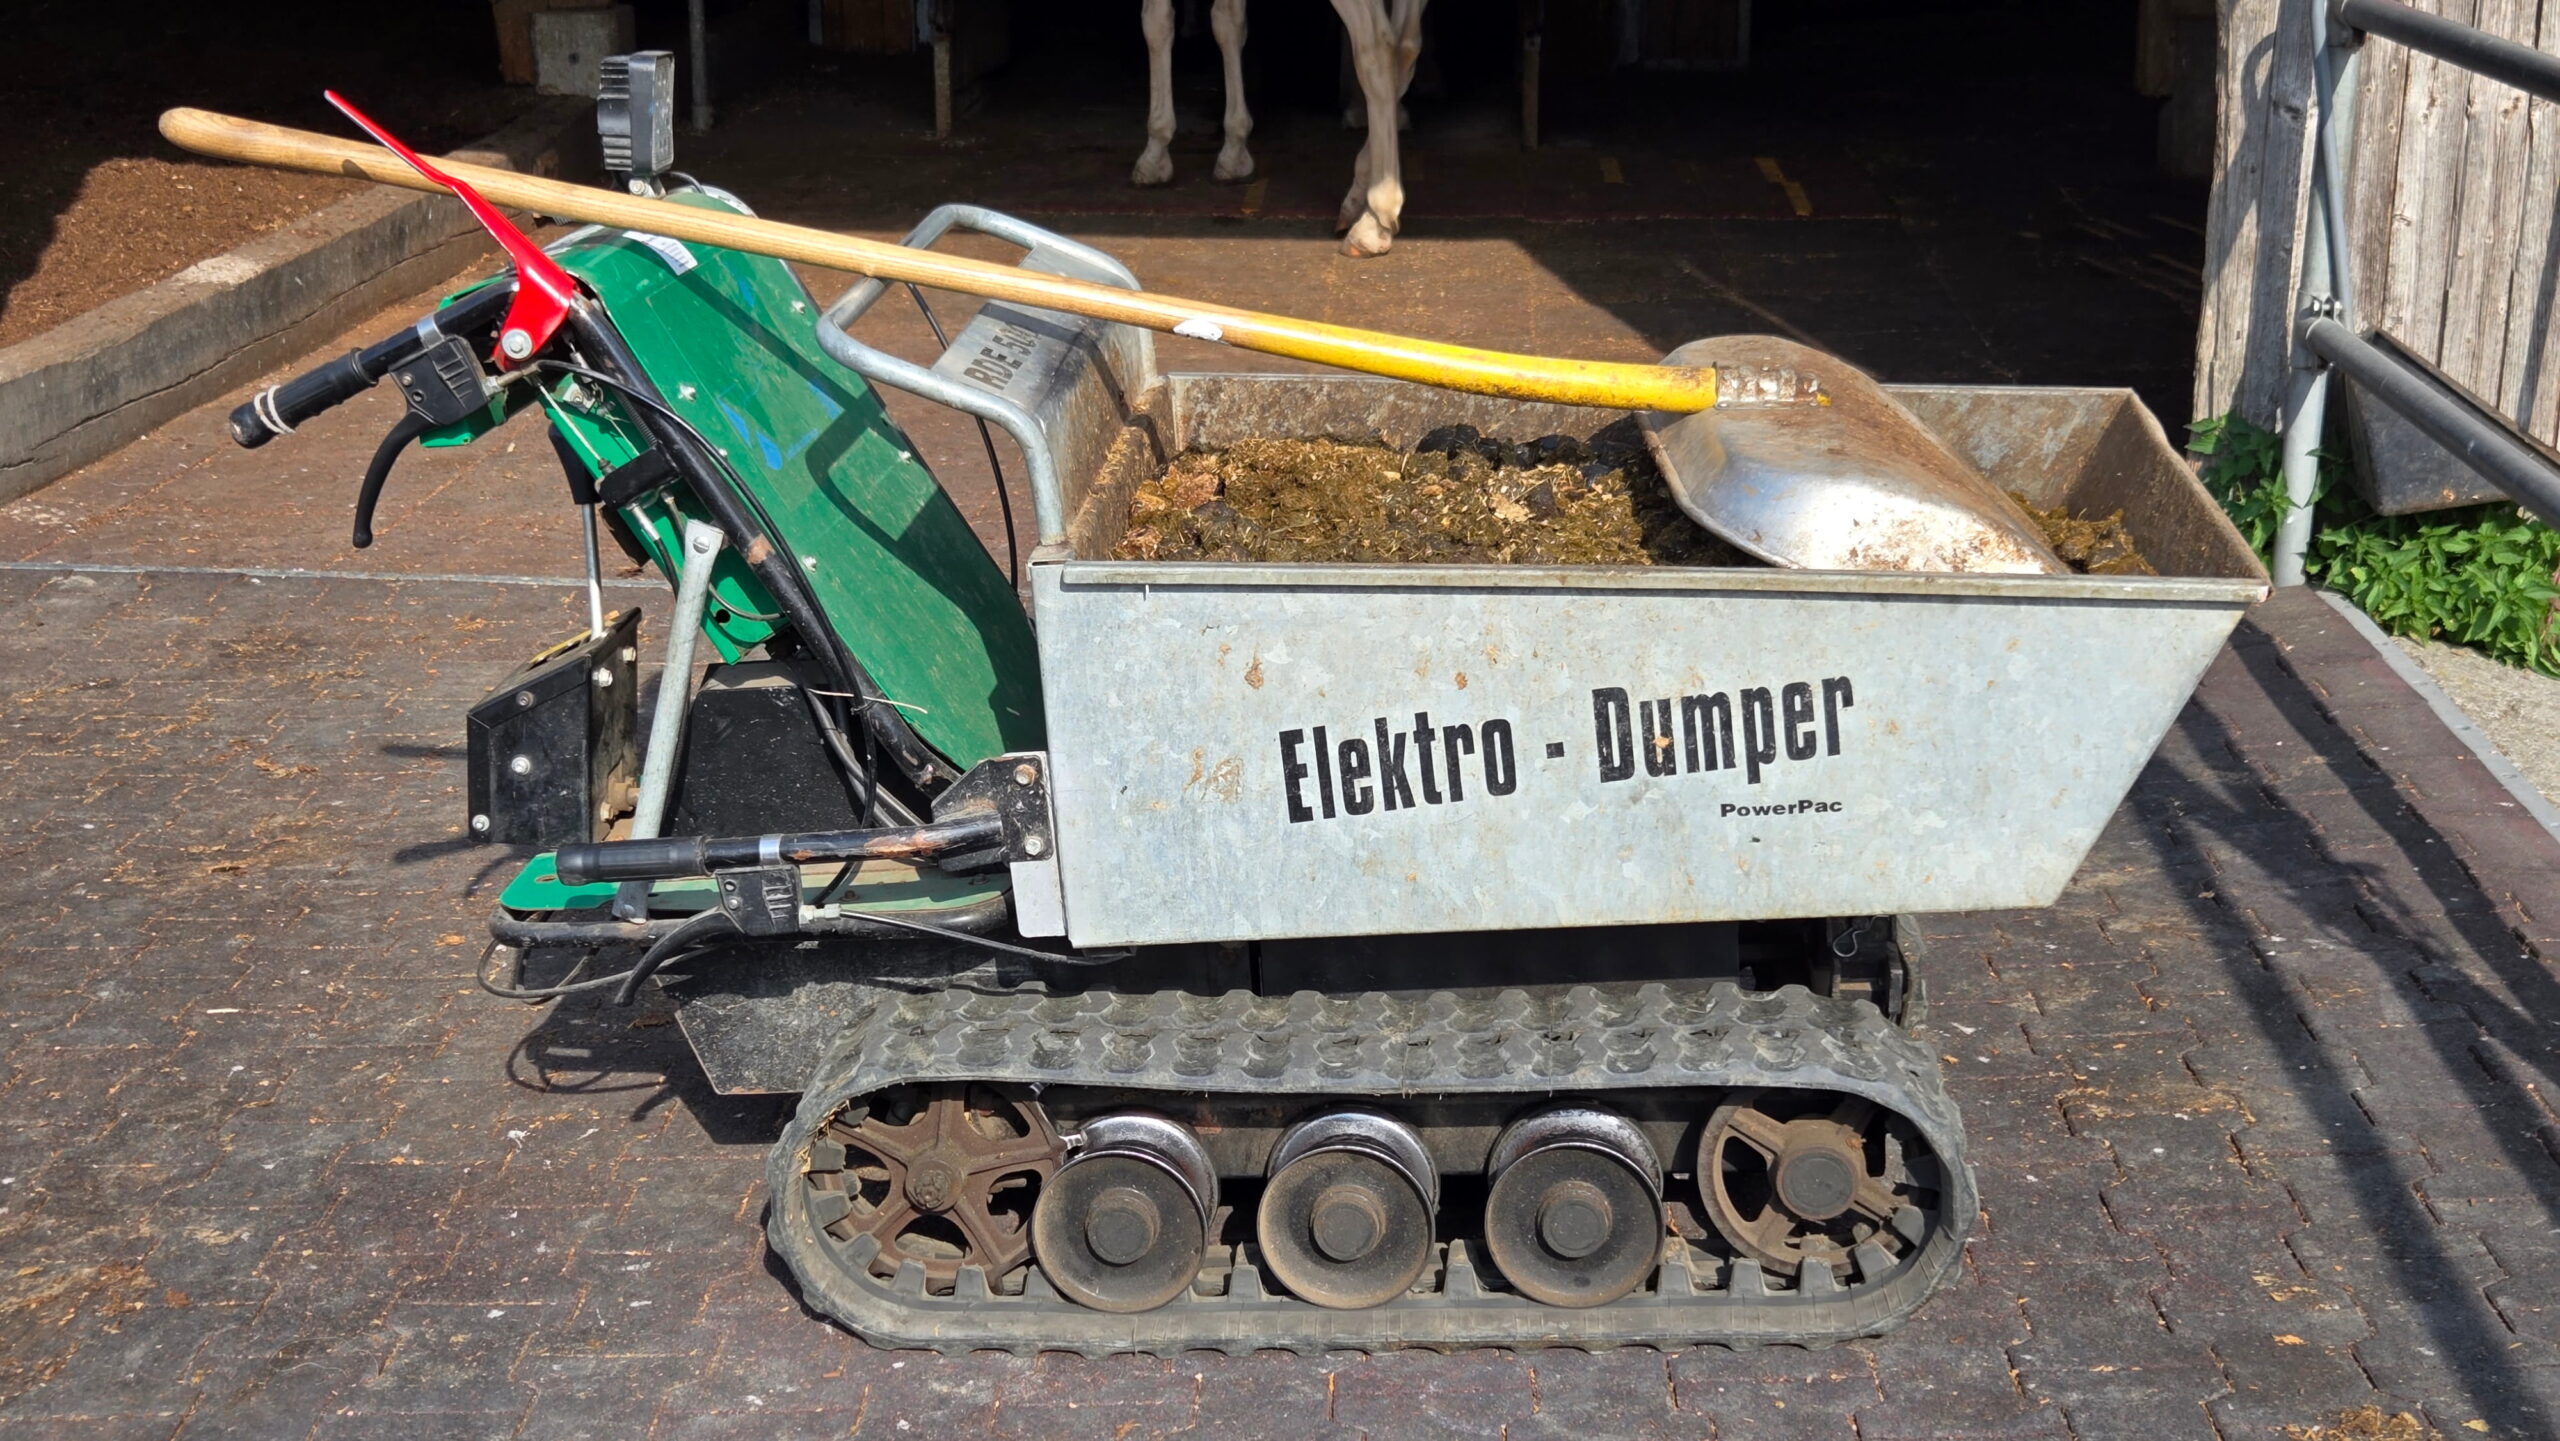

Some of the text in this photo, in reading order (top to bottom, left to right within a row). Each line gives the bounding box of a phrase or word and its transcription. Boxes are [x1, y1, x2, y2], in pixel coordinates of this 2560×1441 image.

[963, 346, 1023, 391] RDE
[1279, 711, 1517, 824] Elektro
[1591, 676, 1854, 785] Dumper
[1720, 799, 1842, 818] PowerPac
